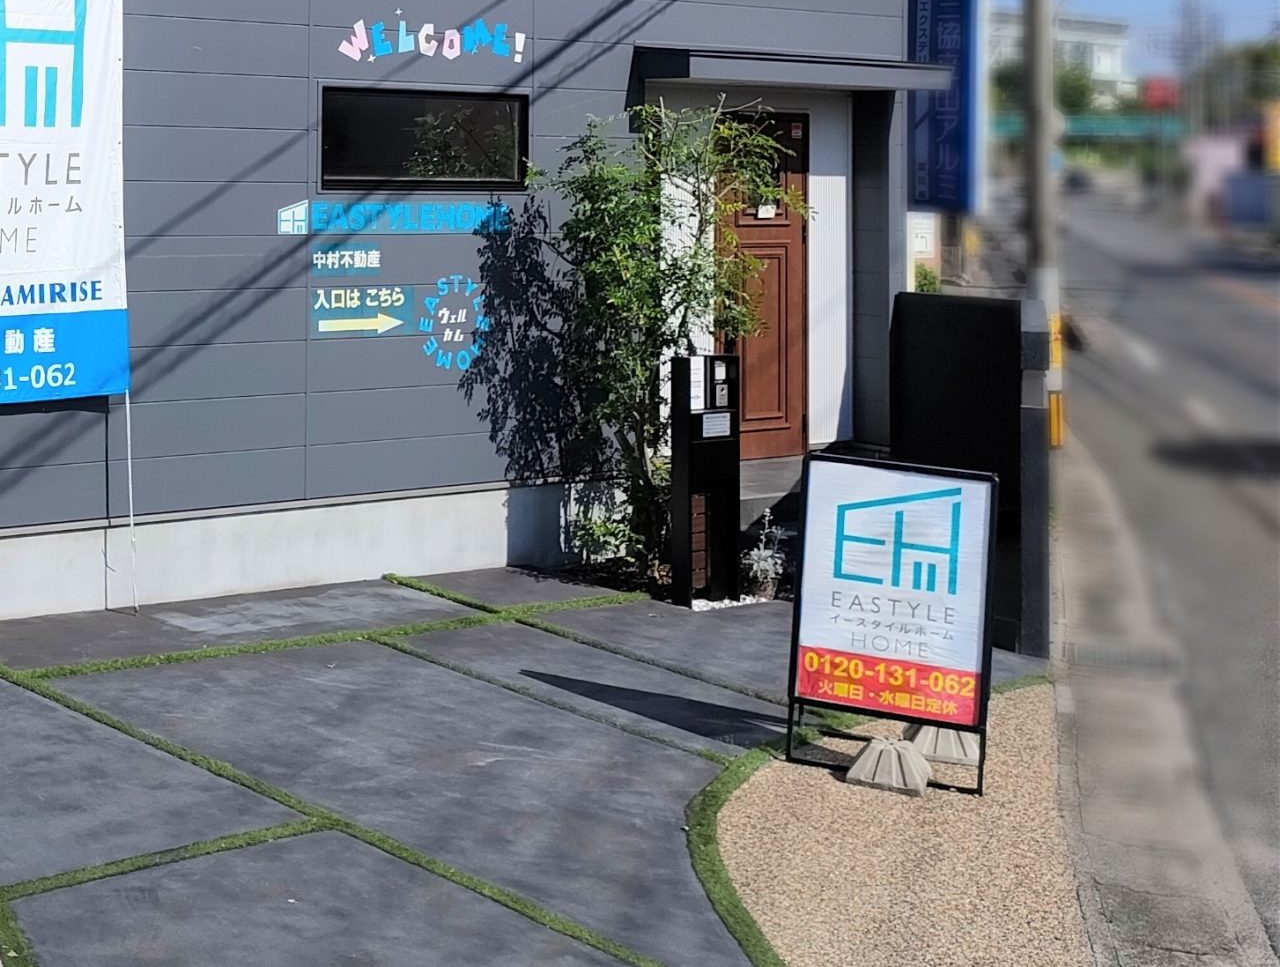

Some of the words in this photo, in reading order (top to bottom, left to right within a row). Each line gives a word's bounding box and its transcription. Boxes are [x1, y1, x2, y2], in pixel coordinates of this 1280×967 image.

[337, 18, 526, 63] WELCOME!
[312, 250, 381, 269] 中村不動産
[831, 590, 956, 625] EASTYLE
[830, 614, 955, 641] イースタイルホーム
[851, 632, 929, 659] HOME
[804, 651, 977, 698] 0120-131-062
